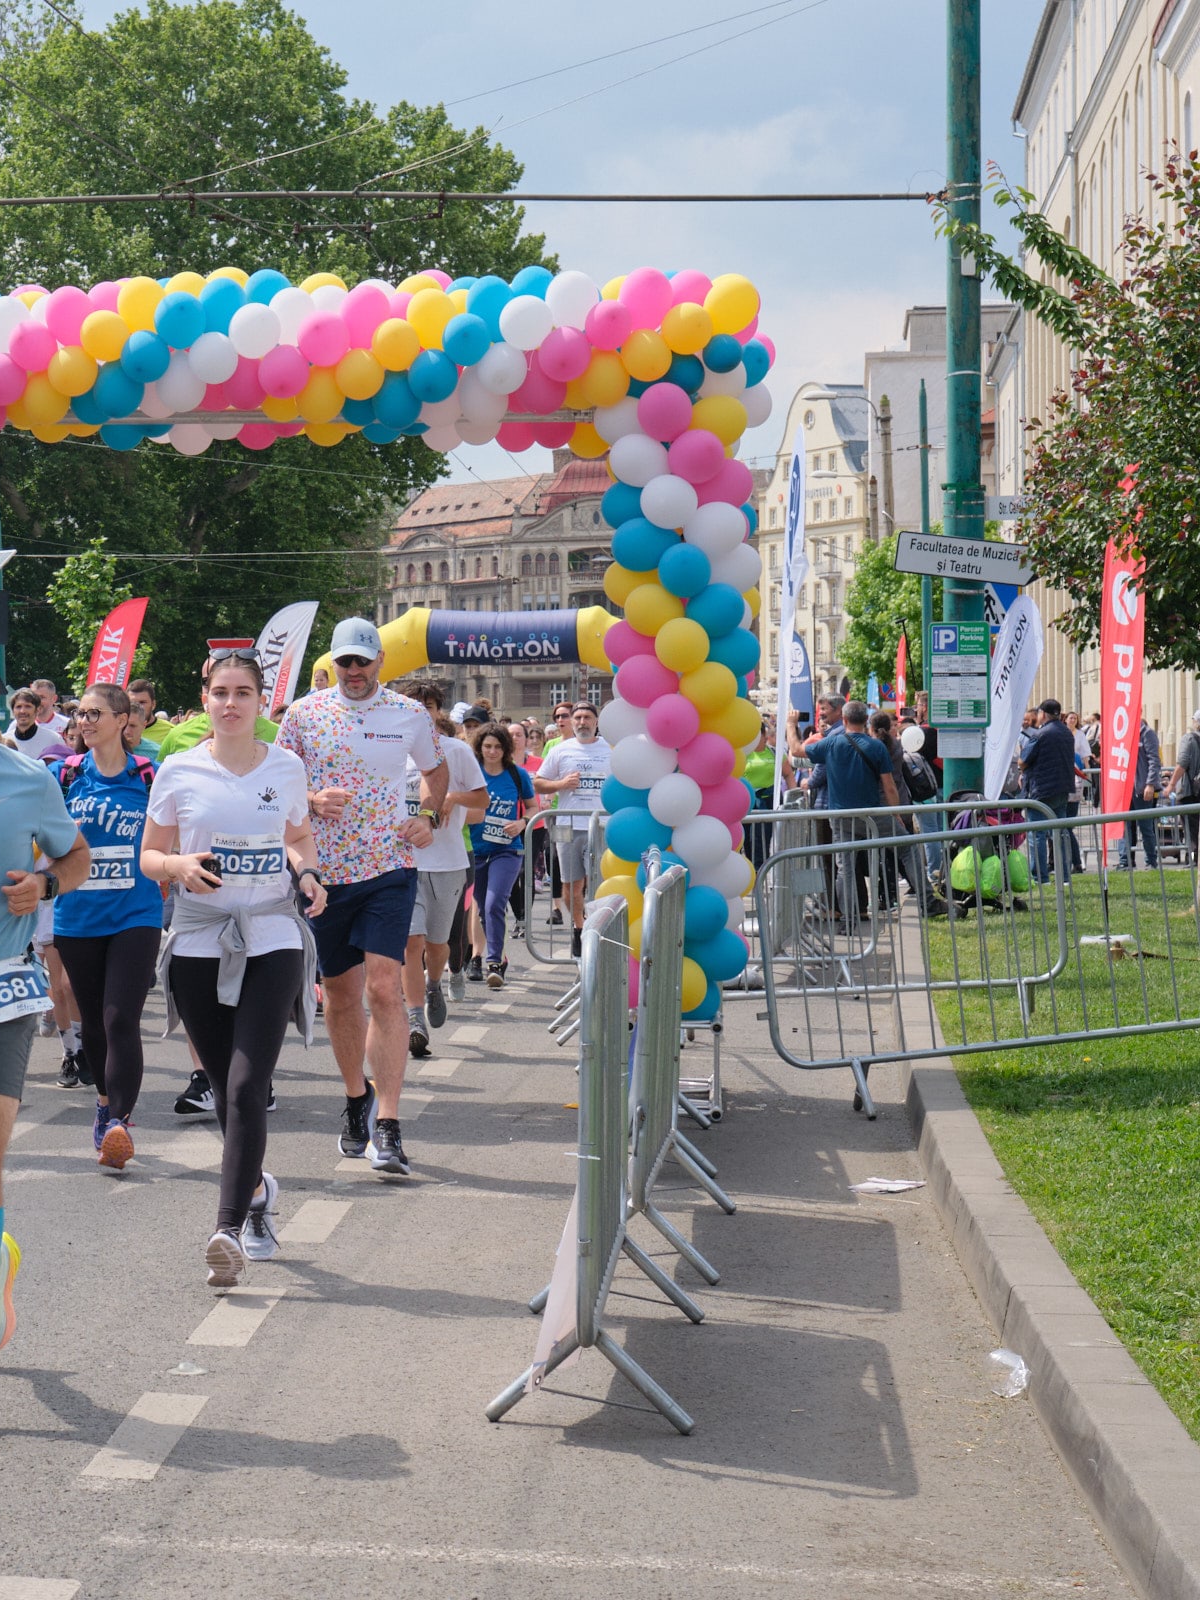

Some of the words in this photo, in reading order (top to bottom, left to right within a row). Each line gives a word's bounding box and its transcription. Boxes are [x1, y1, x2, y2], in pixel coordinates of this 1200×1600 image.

[909, 538, 964, 555] Facultatea
[966, 545, 980, 557] de
[949, 560, 982, 575] Teatru
[960, 634, 985, 642] Parking
[1109, 644, 1135, 783] profi
[120, 810, 145, 820] pentru
[90, 862, 131, 878] 0721
